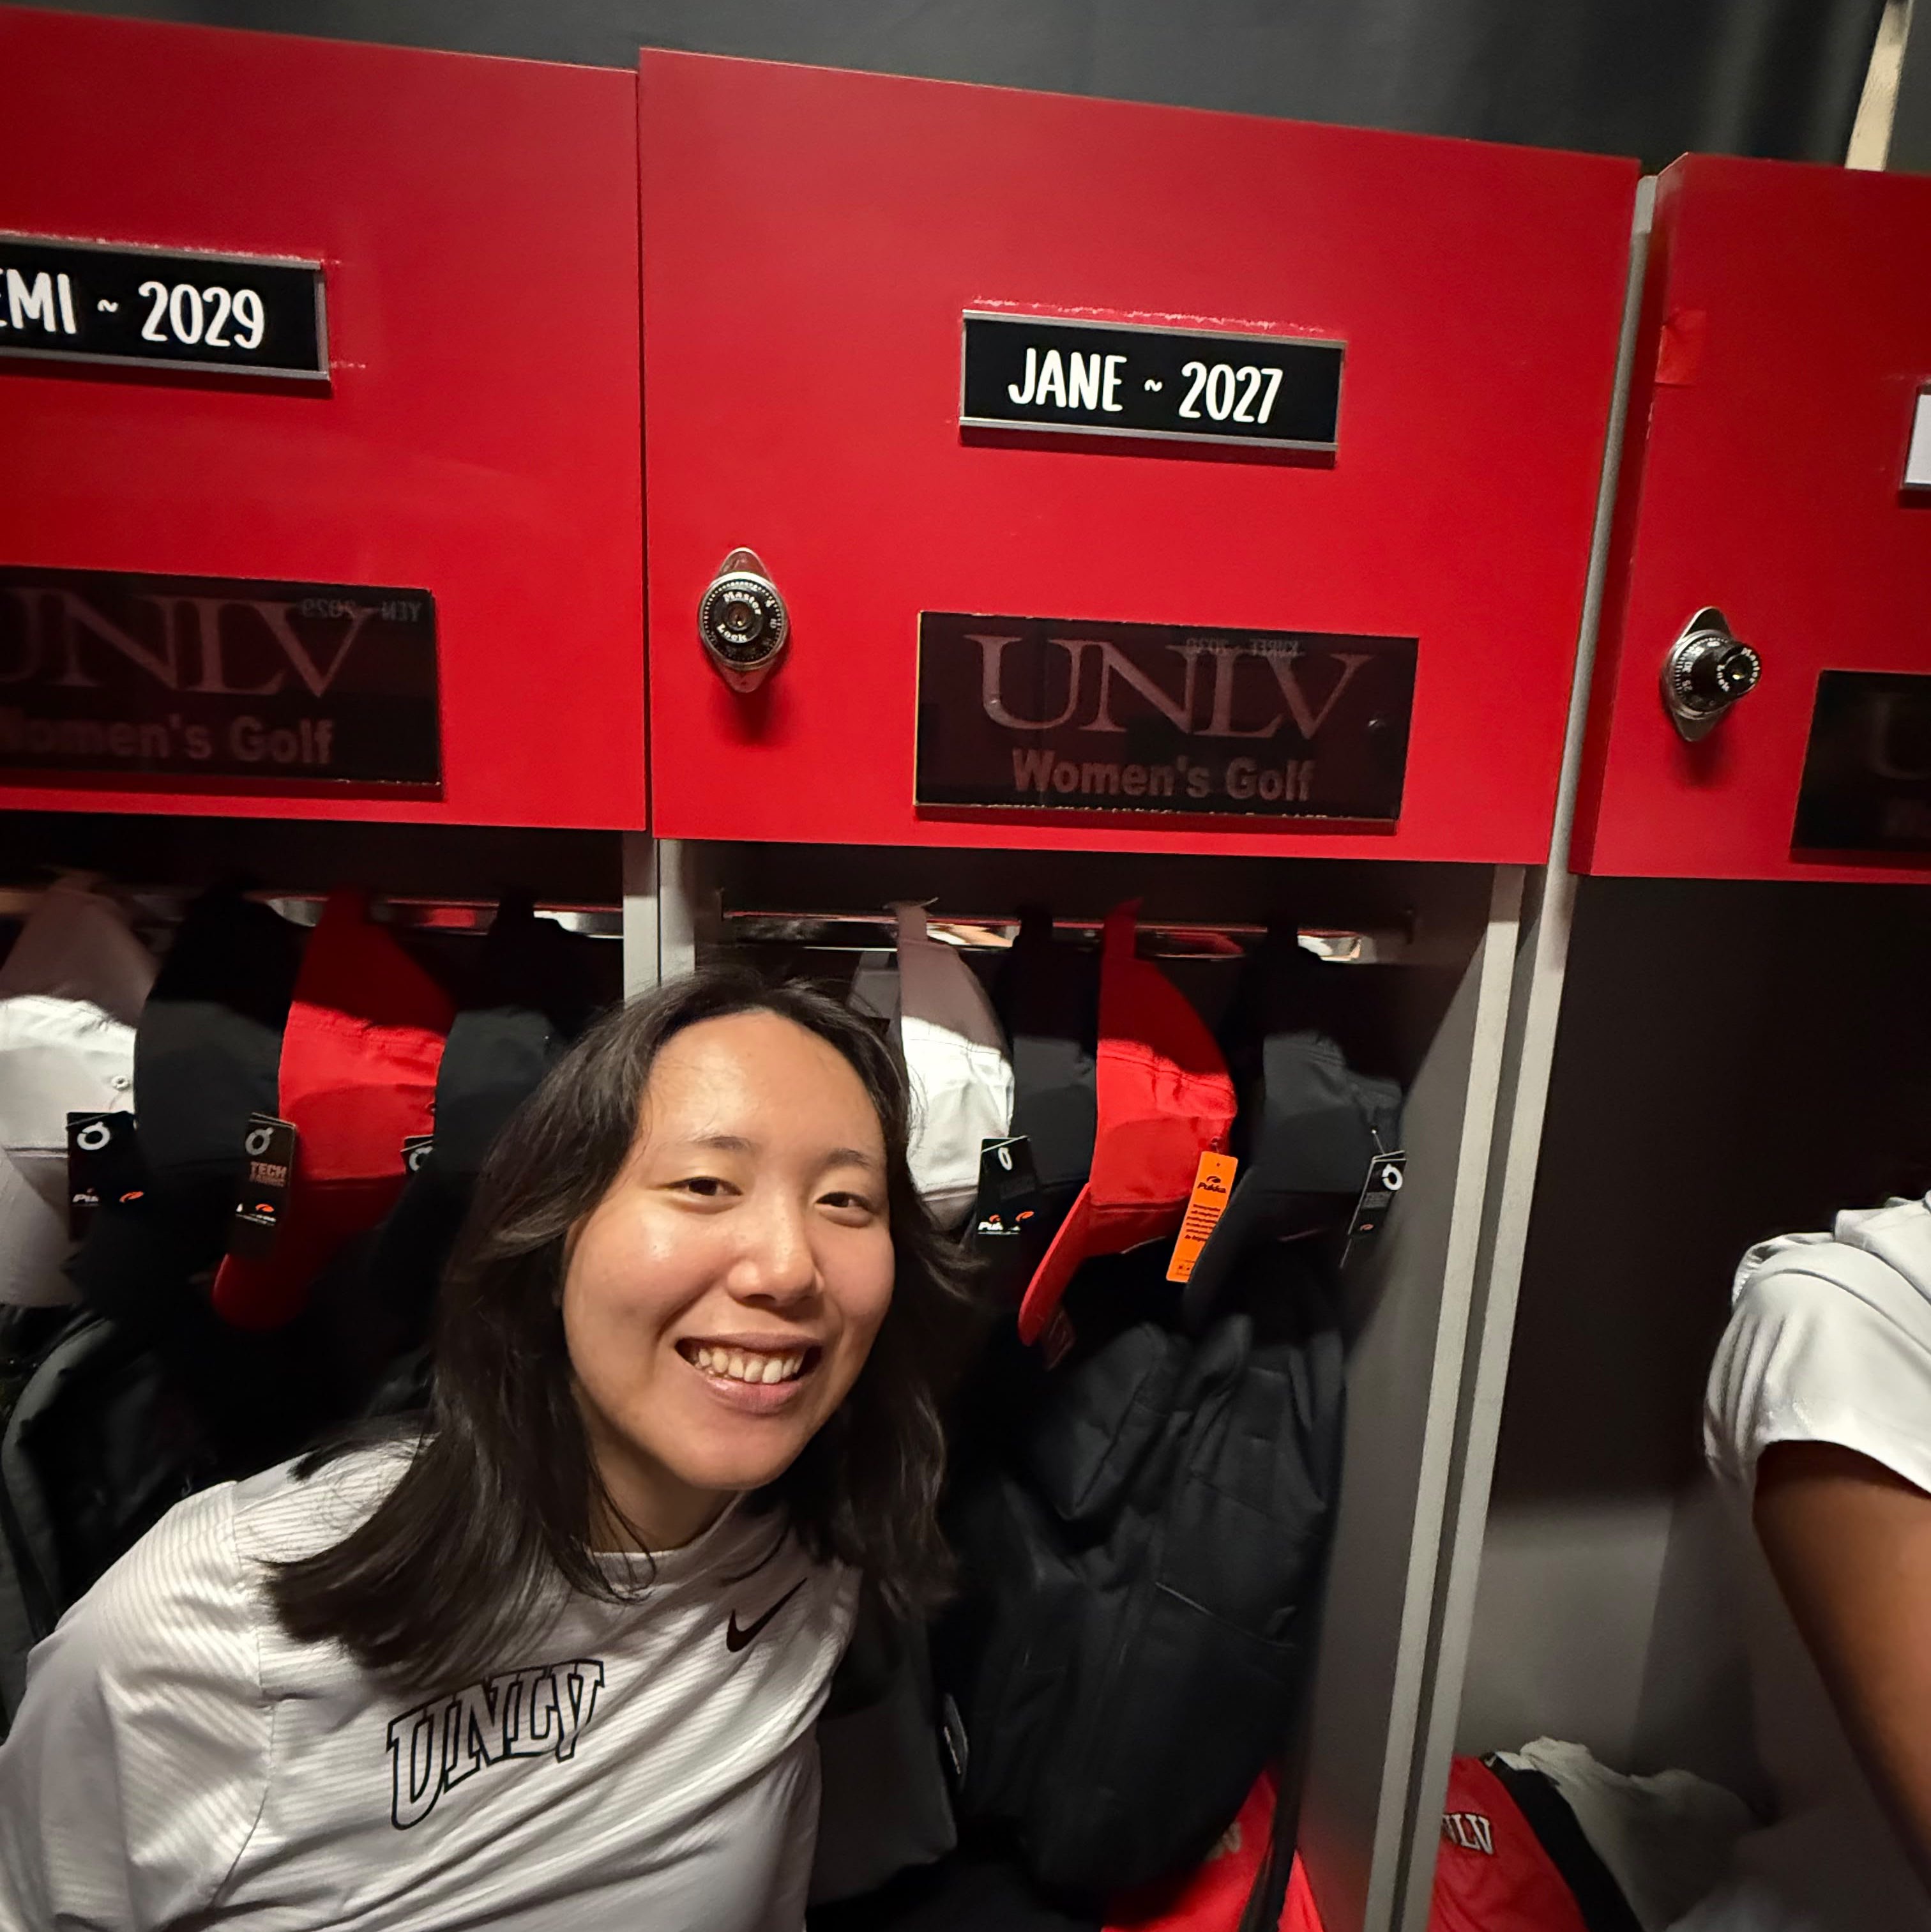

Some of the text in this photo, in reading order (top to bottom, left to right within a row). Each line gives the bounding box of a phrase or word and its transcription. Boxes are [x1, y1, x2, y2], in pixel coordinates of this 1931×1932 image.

[0, 268, 76, 334] MI
[138, 281, 266, 349] 2029
[1008, 348, 1127, 412] JANE
[1178, 361, 1284, 425] 2027
[722, 591, 762, 615] Master
[716, 623, 748, 643] Lock
[962, 634, 1377, 741] UNLV
[229, 715, 336, 765] Golf
[1012, 747, 1316, 802] Women's Golf
[250, 1161, 287, 1179] TECH
[1197, 1182, 1227, 1194] Pukka
[387, 1660, 605, 1830] UNLV
